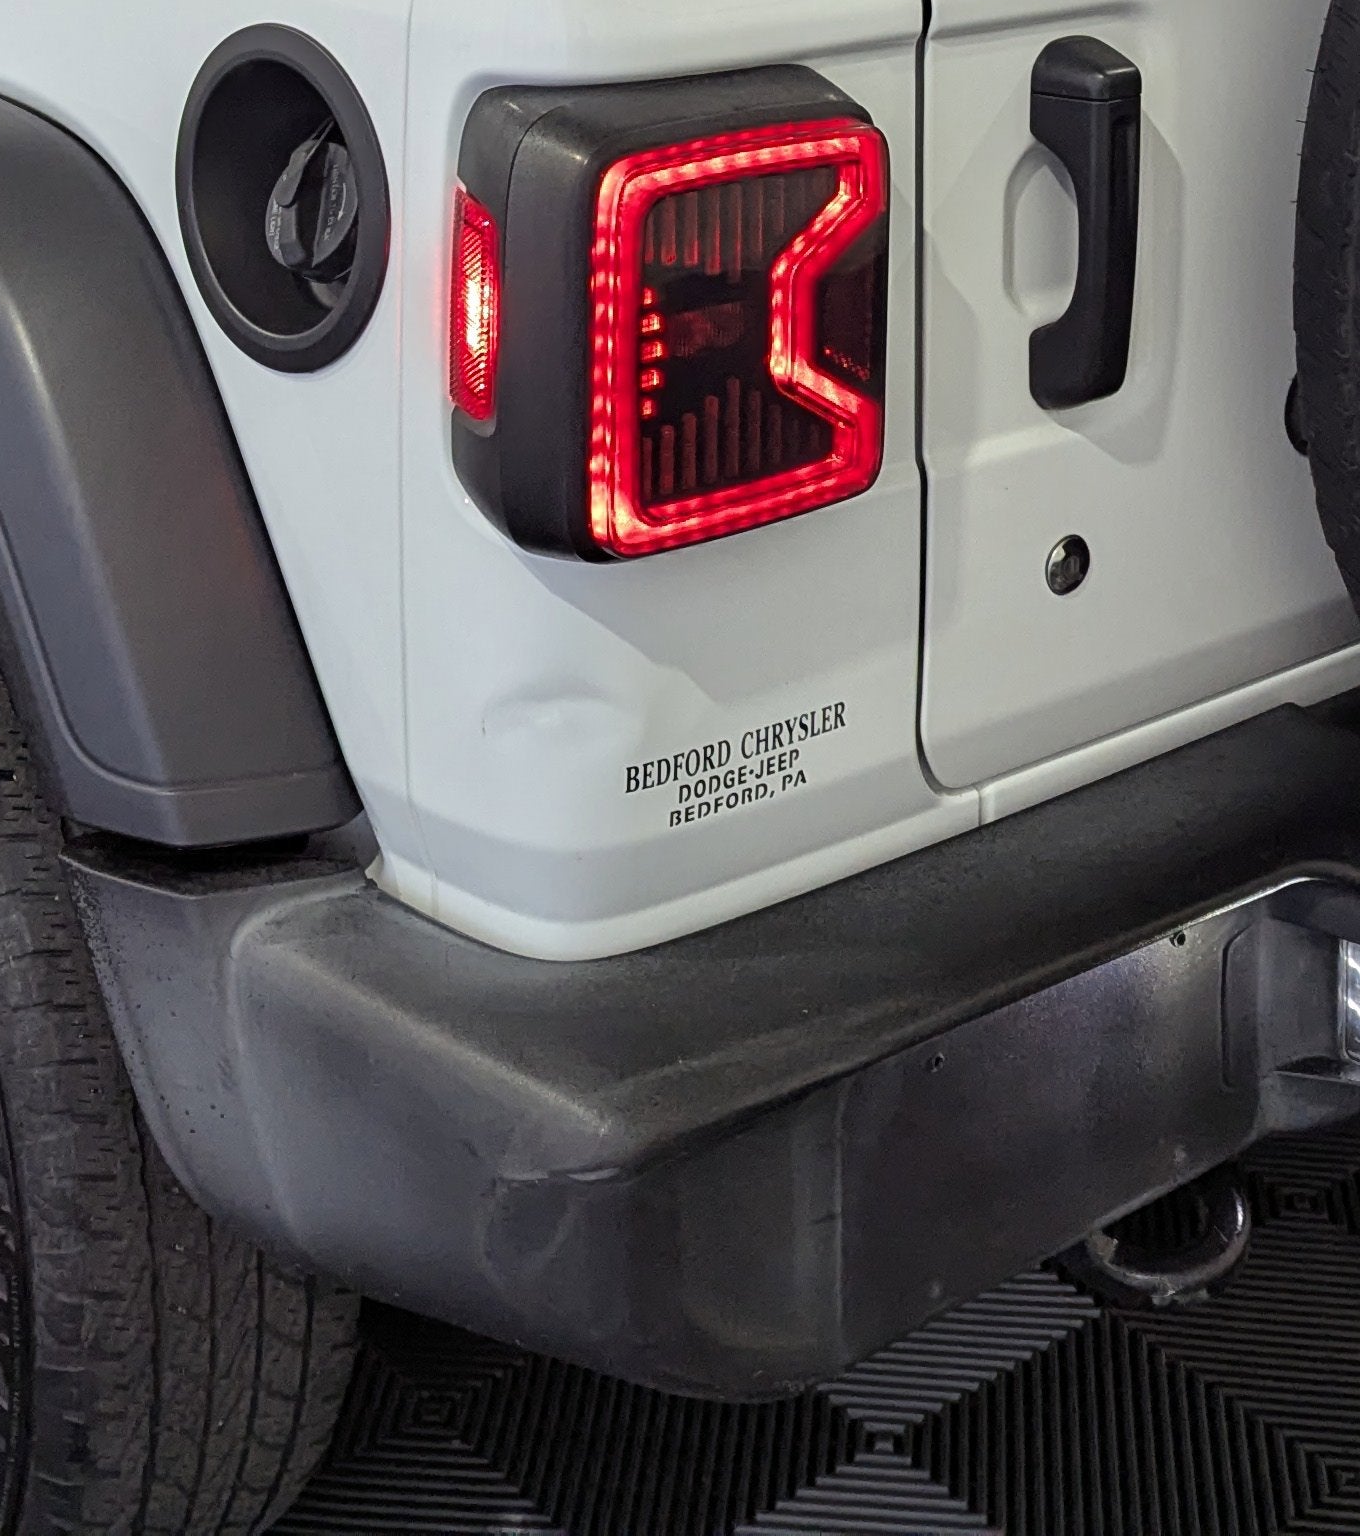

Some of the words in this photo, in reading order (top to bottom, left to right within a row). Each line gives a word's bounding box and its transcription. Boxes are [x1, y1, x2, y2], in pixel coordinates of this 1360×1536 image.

[625, 739, 731, 794] BEDFORD
[741, 700, 847, 760] CHRYSLER
[669, 783, 775, 827] BEDFORD,
[781, 769, 807, 792] PA
